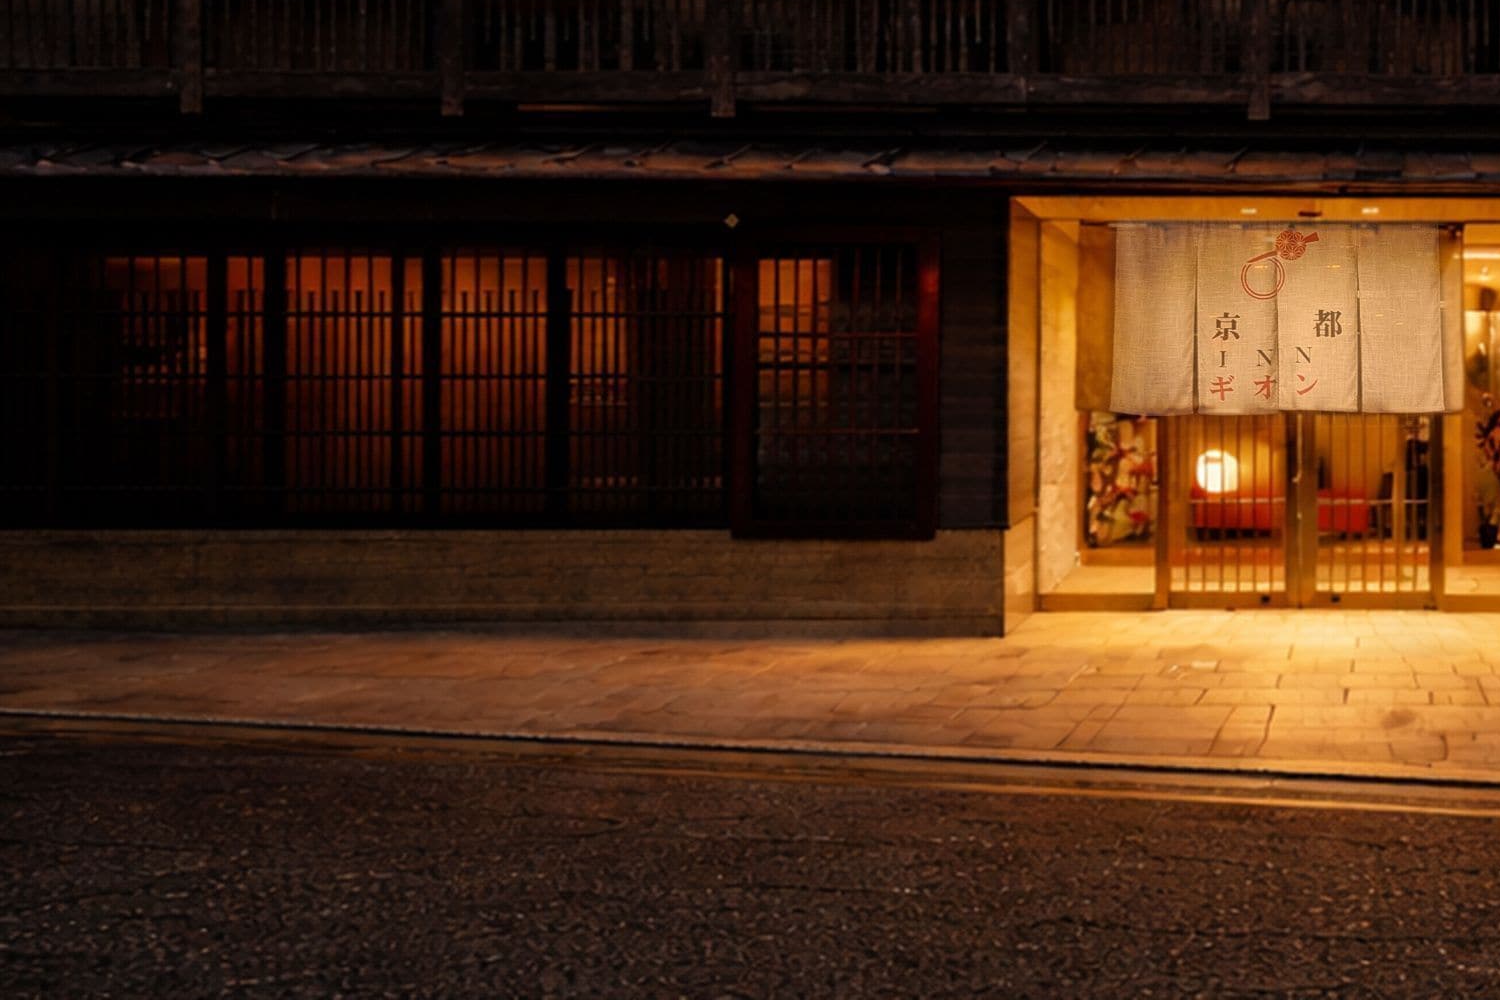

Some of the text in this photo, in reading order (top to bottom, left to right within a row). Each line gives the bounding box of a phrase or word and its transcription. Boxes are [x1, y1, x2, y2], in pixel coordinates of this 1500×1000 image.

[1211, 309, 1342, 341] 京都
[1209, 374, 1318, 401] ギオン
